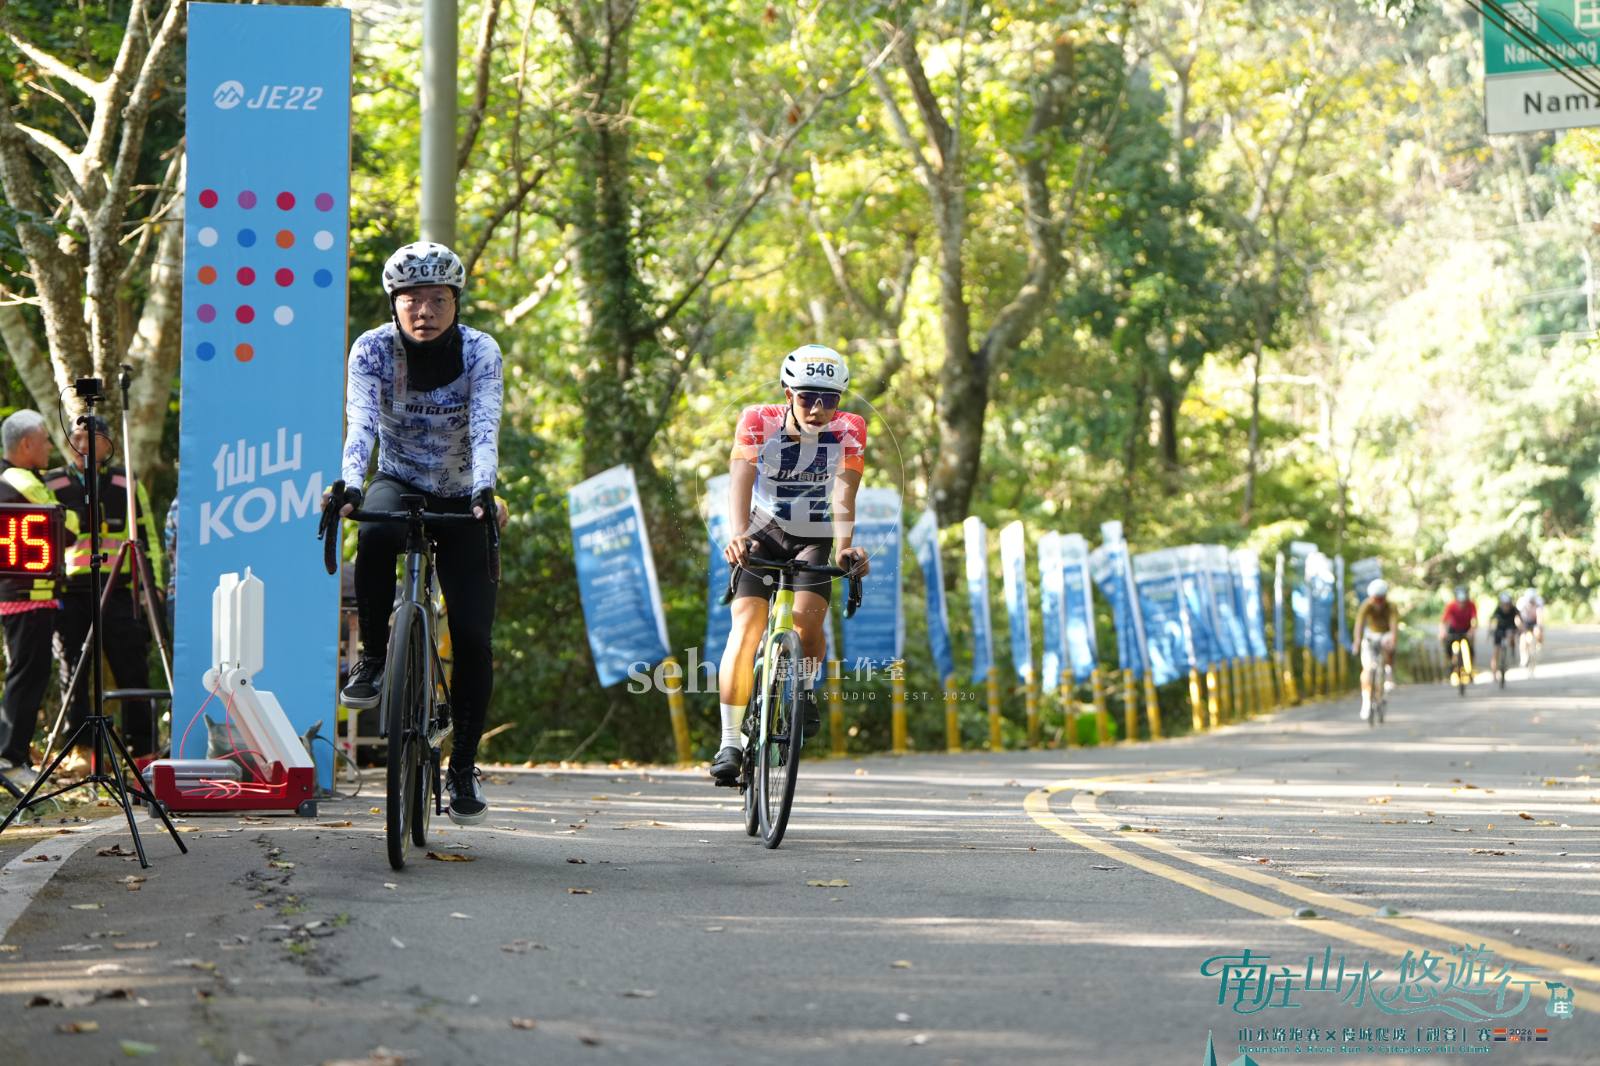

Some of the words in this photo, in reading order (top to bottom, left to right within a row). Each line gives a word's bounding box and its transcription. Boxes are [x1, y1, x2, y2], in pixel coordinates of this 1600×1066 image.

[247, 85, 323, 110] JE22
[806, 362, 835, 377] 546
[212, 427, 302, 492] 仙山
[200, 471, 322, 545] KOM
